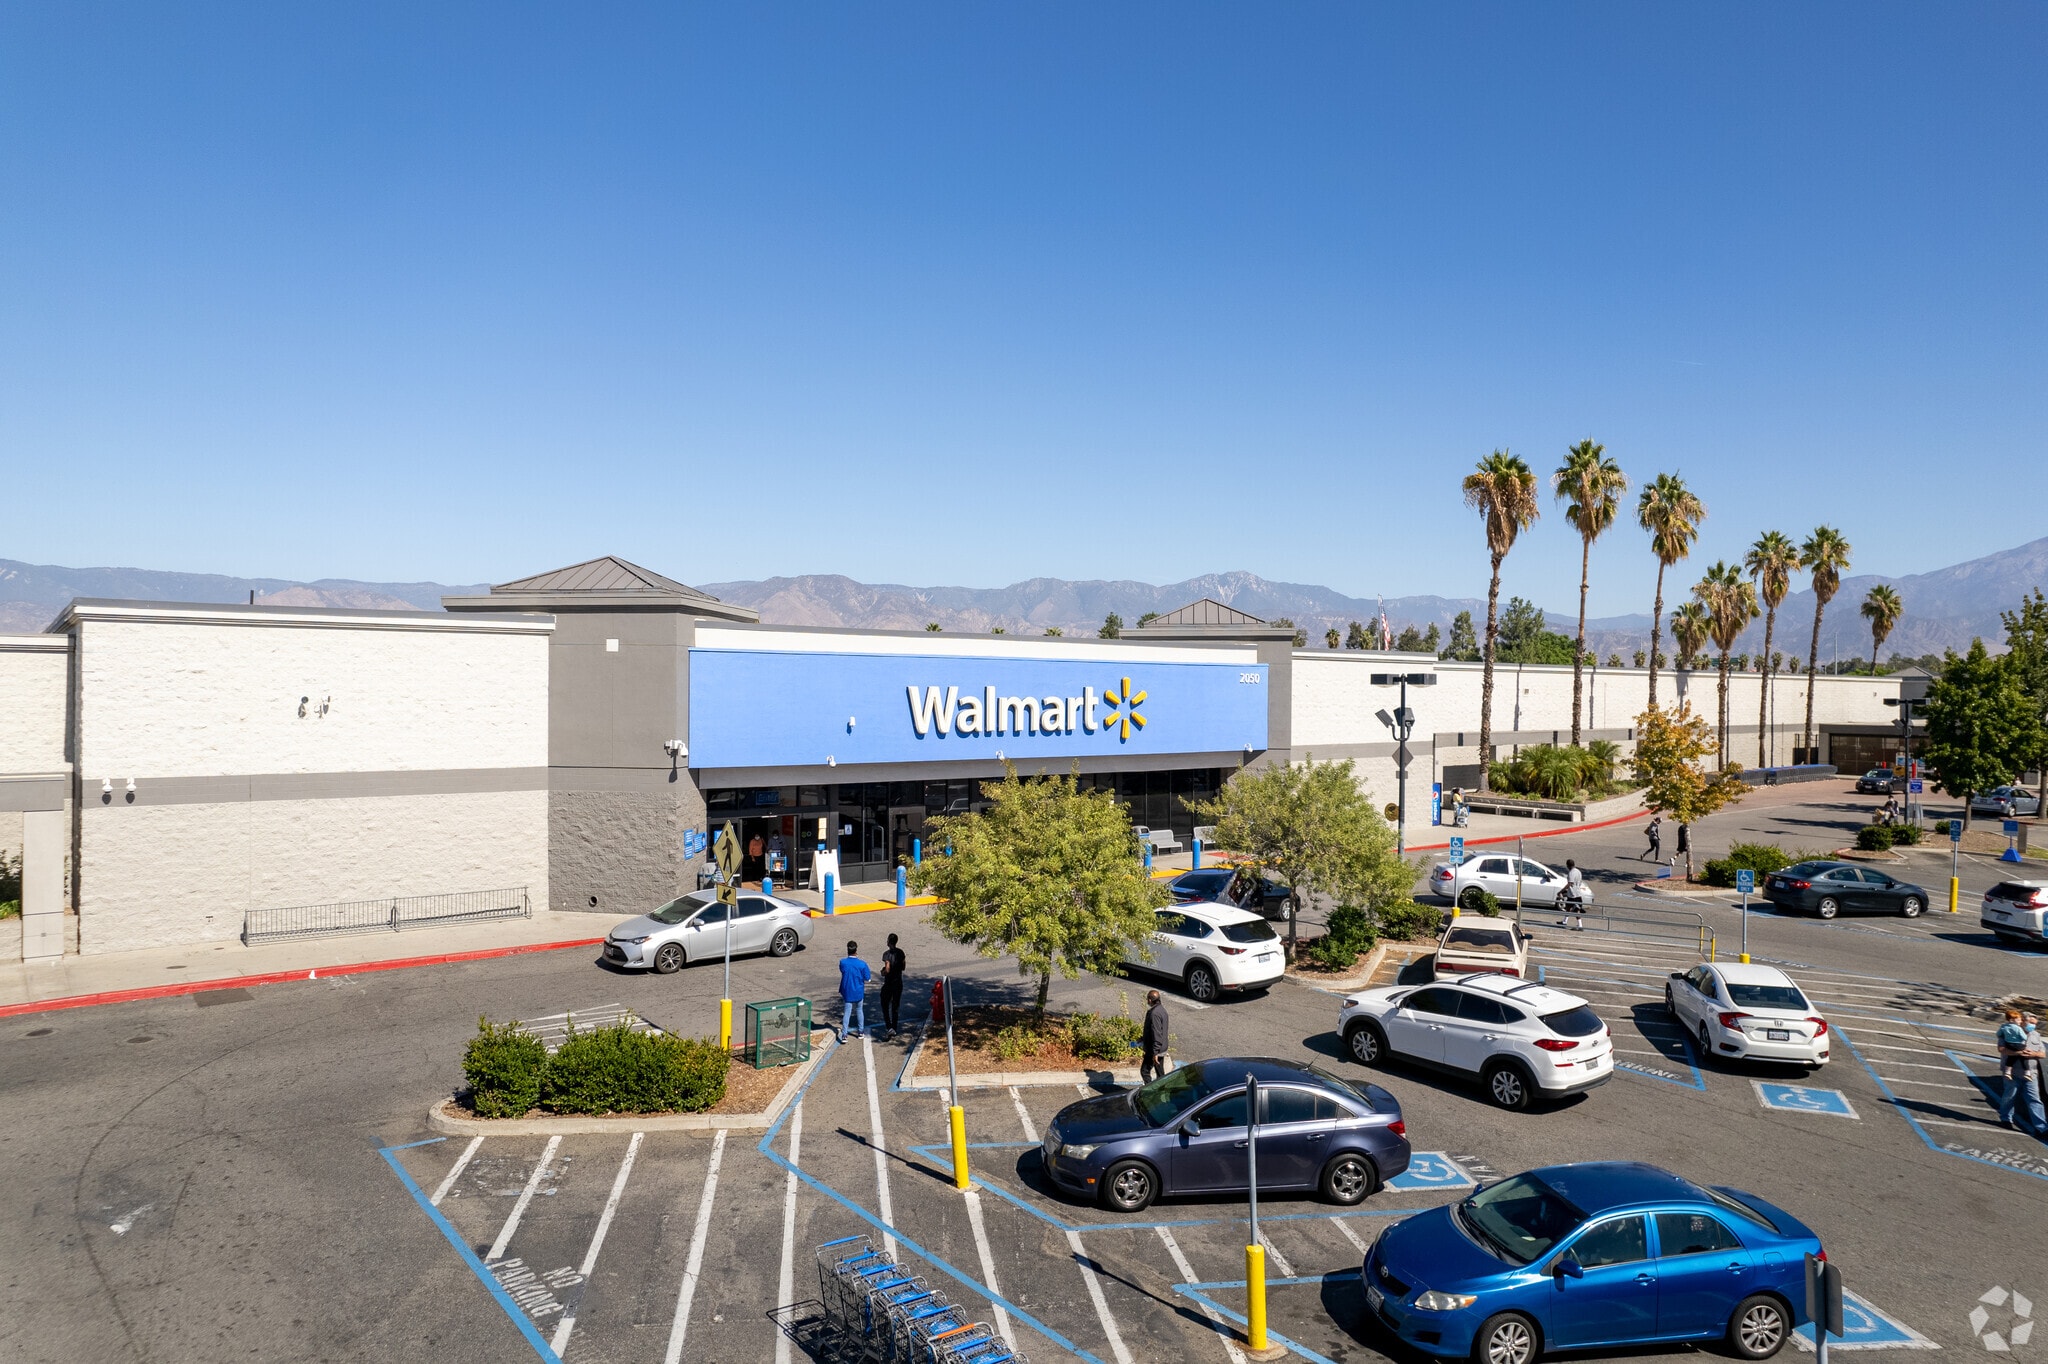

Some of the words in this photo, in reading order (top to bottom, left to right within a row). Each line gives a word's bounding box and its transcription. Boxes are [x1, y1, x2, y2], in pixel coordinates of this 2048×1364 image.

[1239, 672, 1260, 684] 2050
[907, 685, 1100, 735] Walmart
[1944, 1143, 2048, 1177] PARKIN
[486, 1258, 564, 1319] PARKING
[542, 1266, 583, 1289] NO
